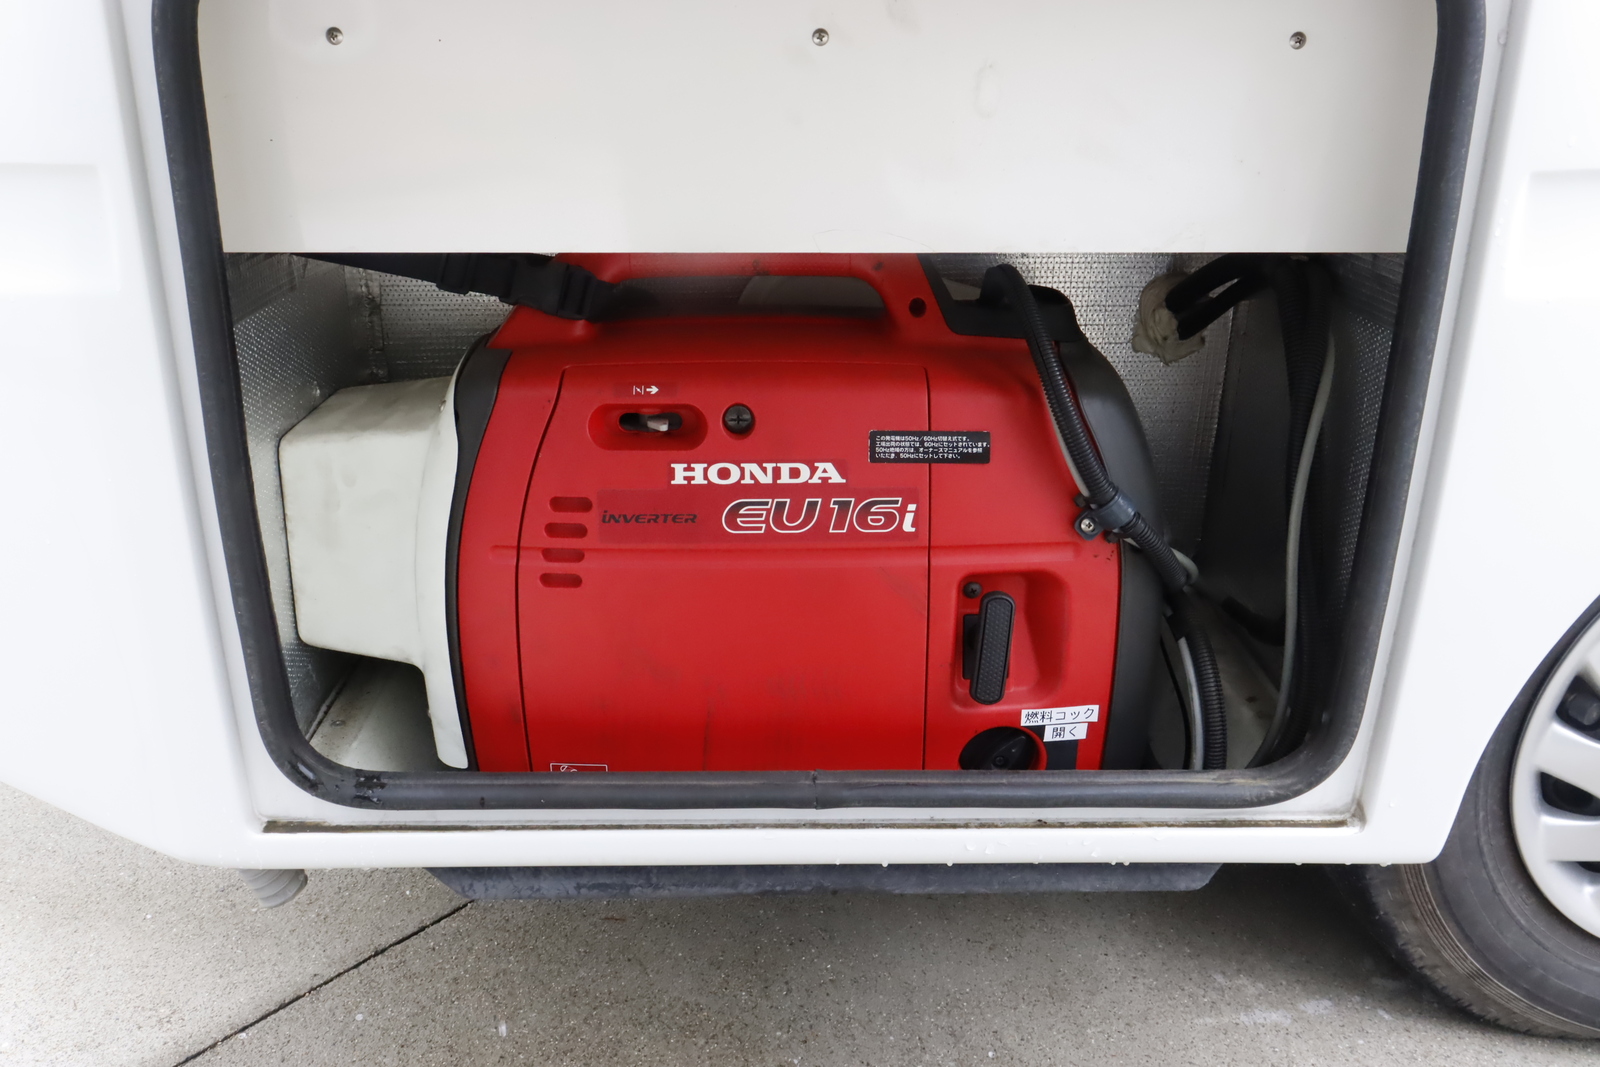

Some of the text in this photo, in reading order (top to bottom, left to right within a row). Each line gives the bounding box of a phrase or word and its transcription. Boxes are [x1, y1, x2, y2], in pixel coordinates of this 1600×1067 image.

[670, 463, 846, 484] HONDA
[1024, 708, 1095, 724] 燃料コック
[1051, 726, 1078, 739] 開く
